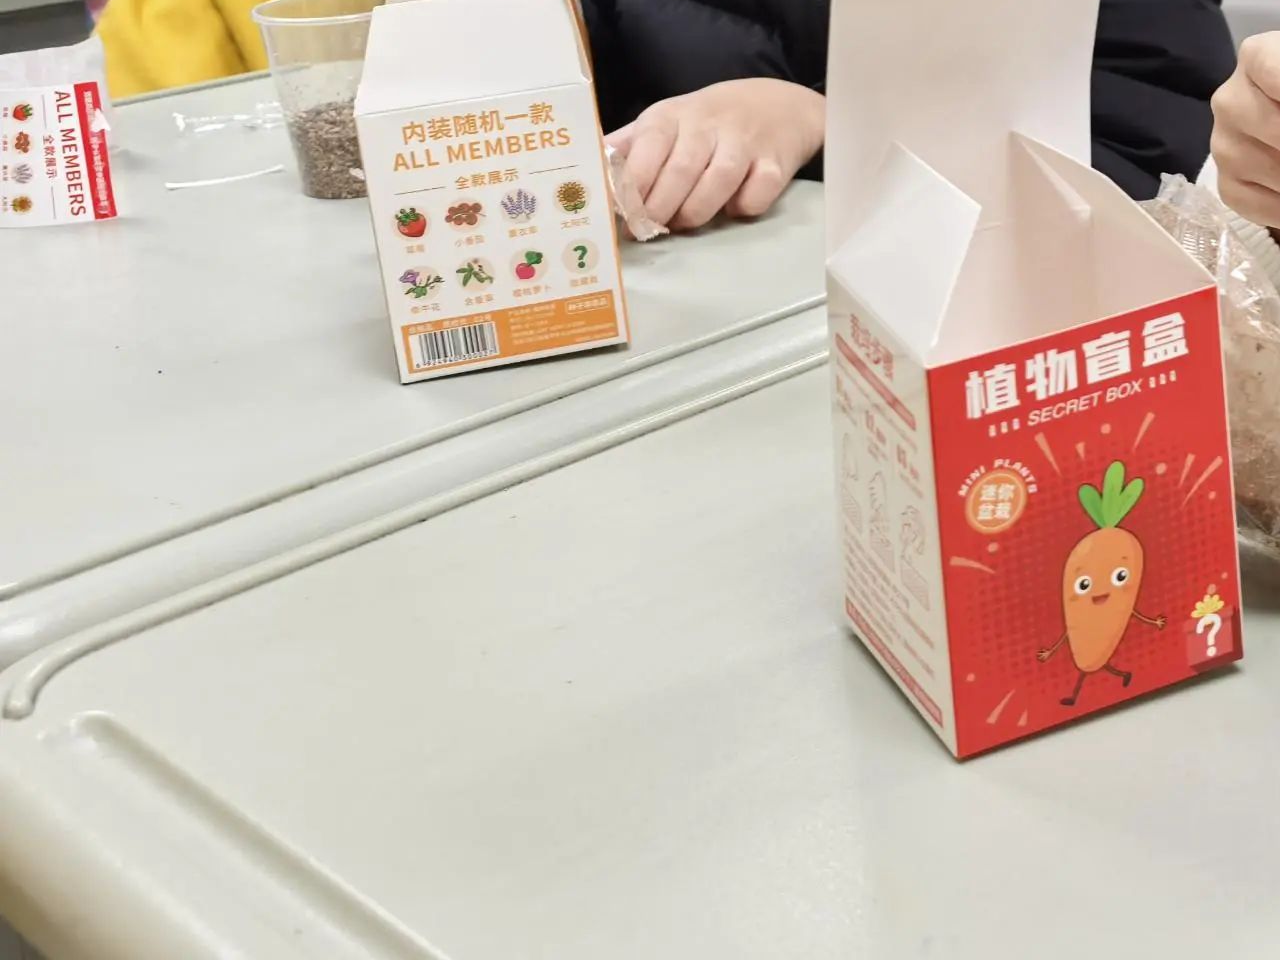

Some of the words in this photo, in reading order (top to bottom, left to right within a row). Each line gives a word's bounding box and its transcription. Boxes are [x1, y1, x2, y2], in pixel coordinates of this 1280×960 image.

[54, 90, 74, 124] ALL
[401, 101, 555, 146] 内装随机一款
[393, 148, 440, 172] ALL
[447, 127, 572, 165] MEMBERS
[60, 128, 87, 217] MEMBERS
[455, 167, 520, 191] 全款展示
[965, 311, 1189, 420] 植物盲盒
[1027, 389, 1103, 427] SECRET
[1105, 378, 1143, 403] BOX
[957, 465, 986, 498] MINI
